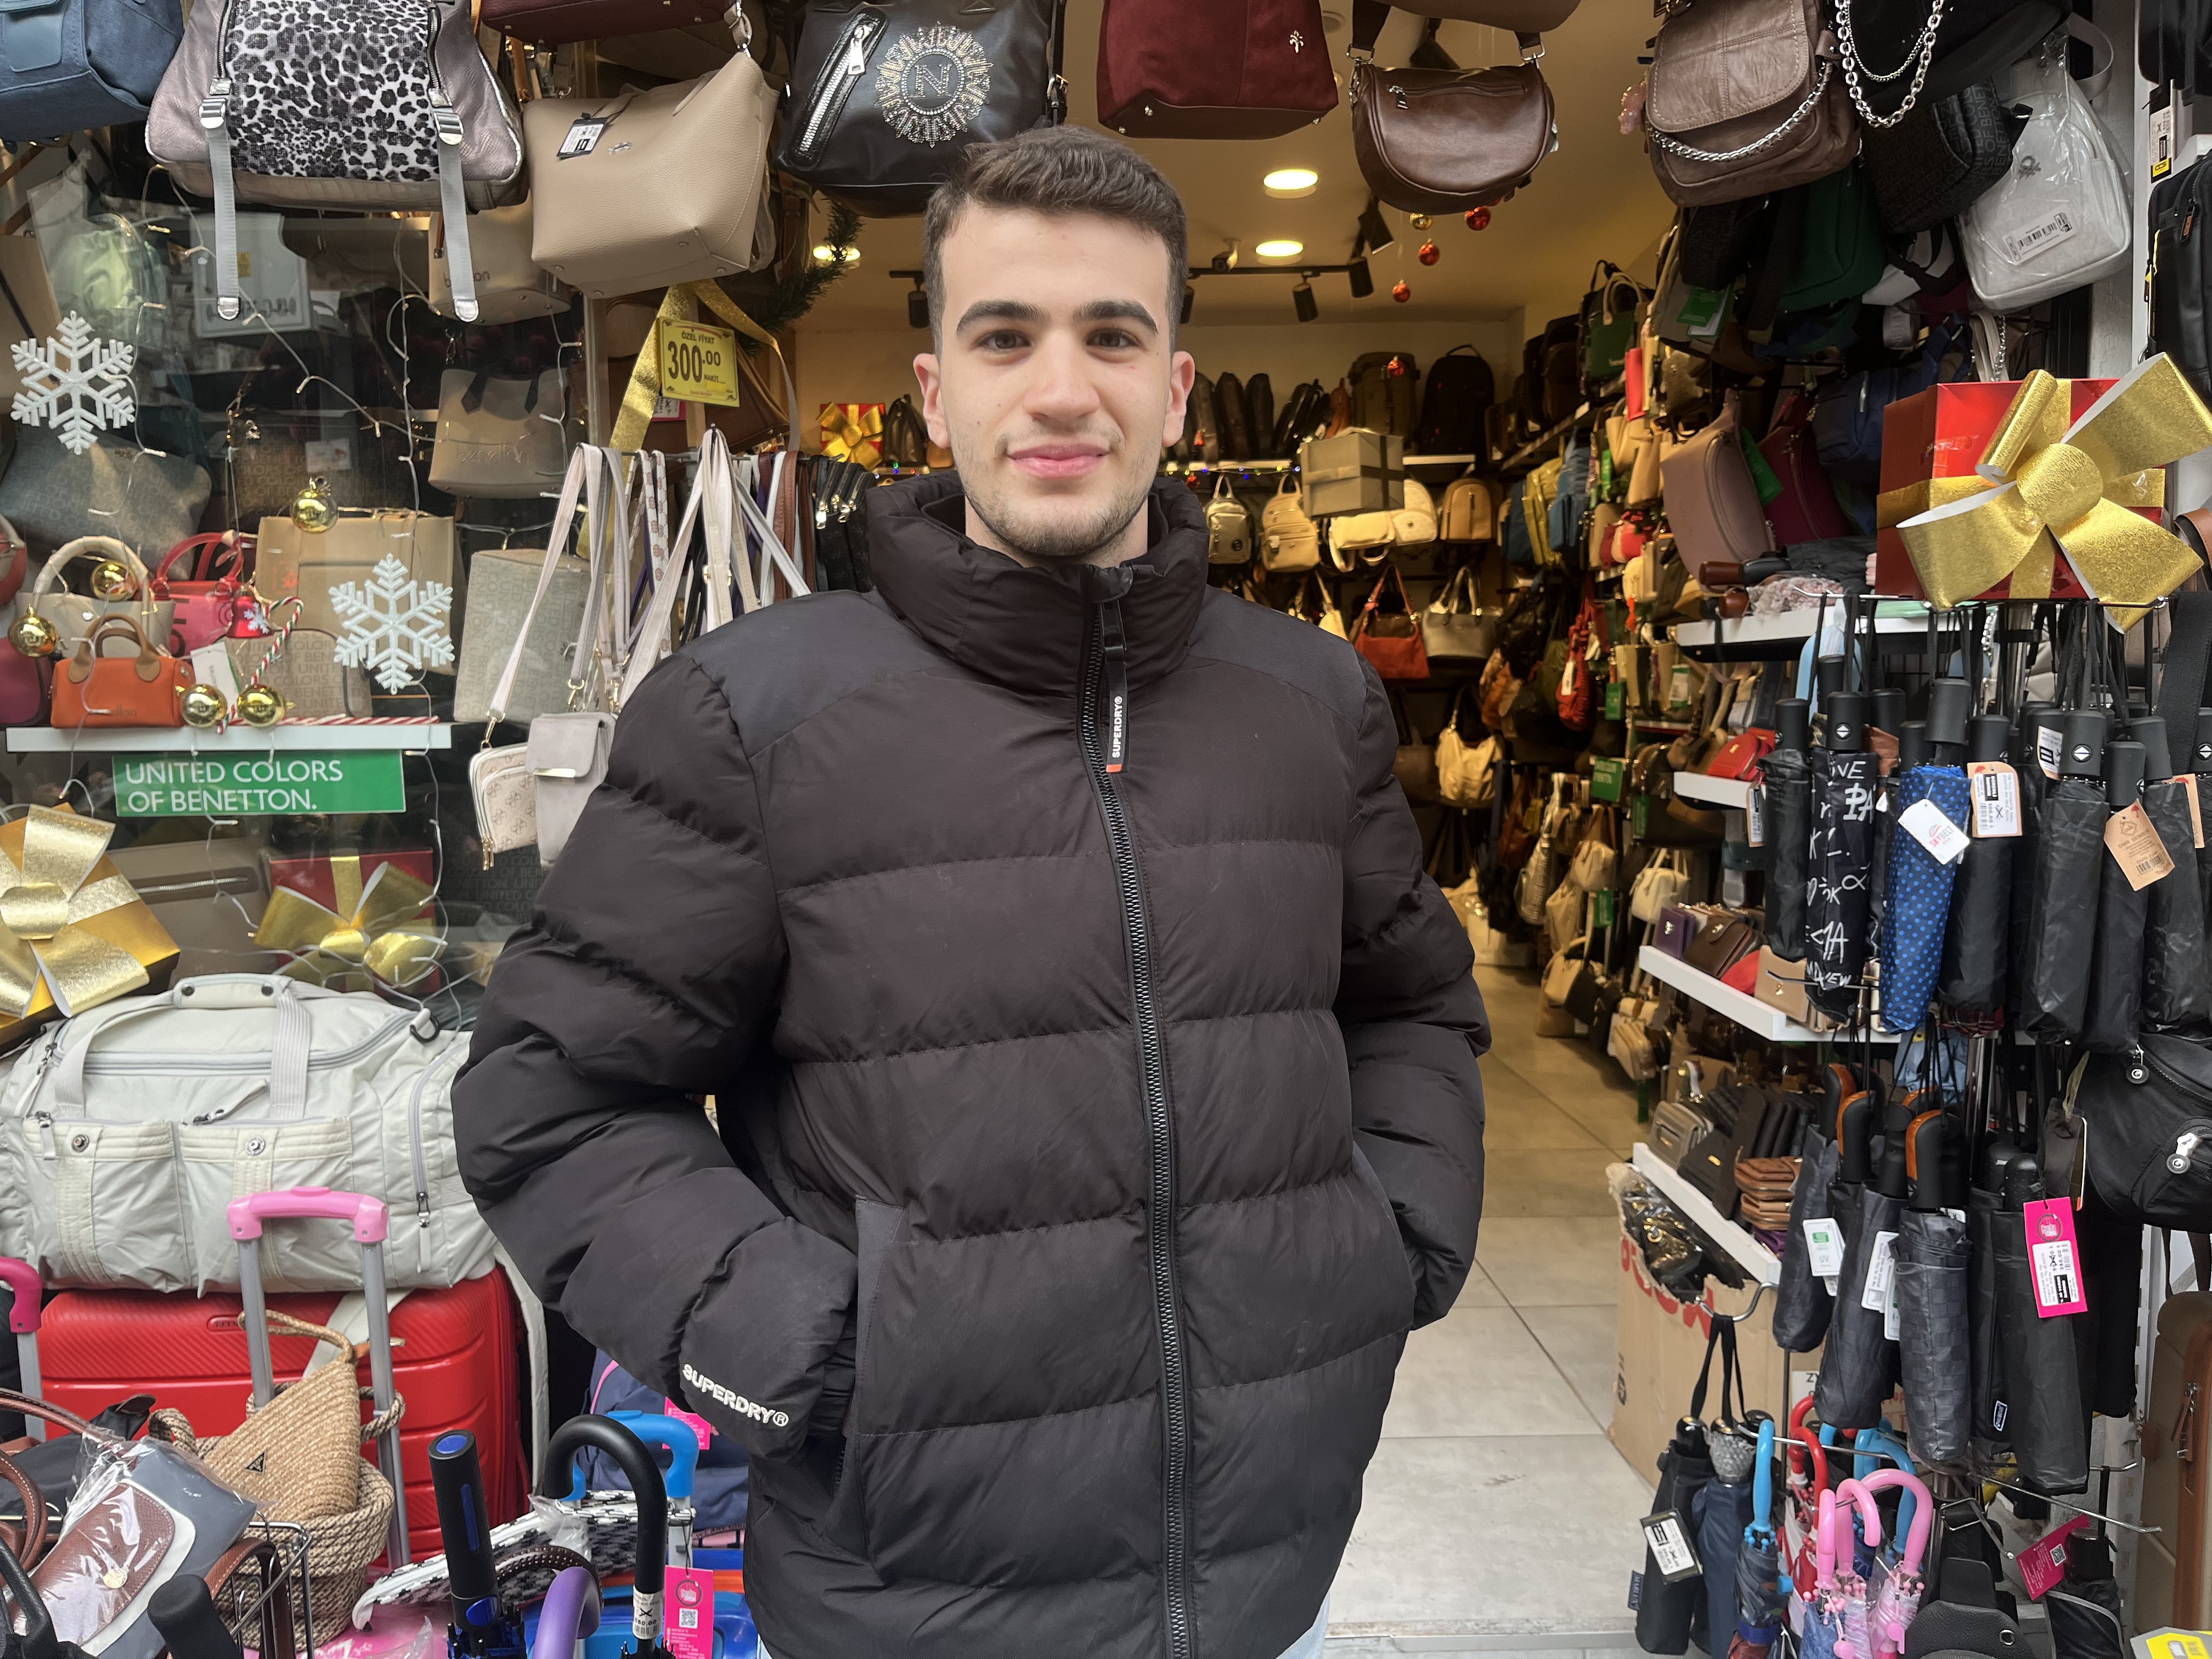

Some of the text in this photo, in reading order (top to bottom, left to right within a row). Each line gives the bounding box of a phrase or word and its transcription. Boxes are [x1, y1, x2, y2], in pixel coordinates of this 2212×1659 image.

[681, 330, 715, 344] ÖZEL FİYAT
[125, 759, 343, 785] UNITED COLORS
[128, 788, 318, 813] OF BENETTON.
